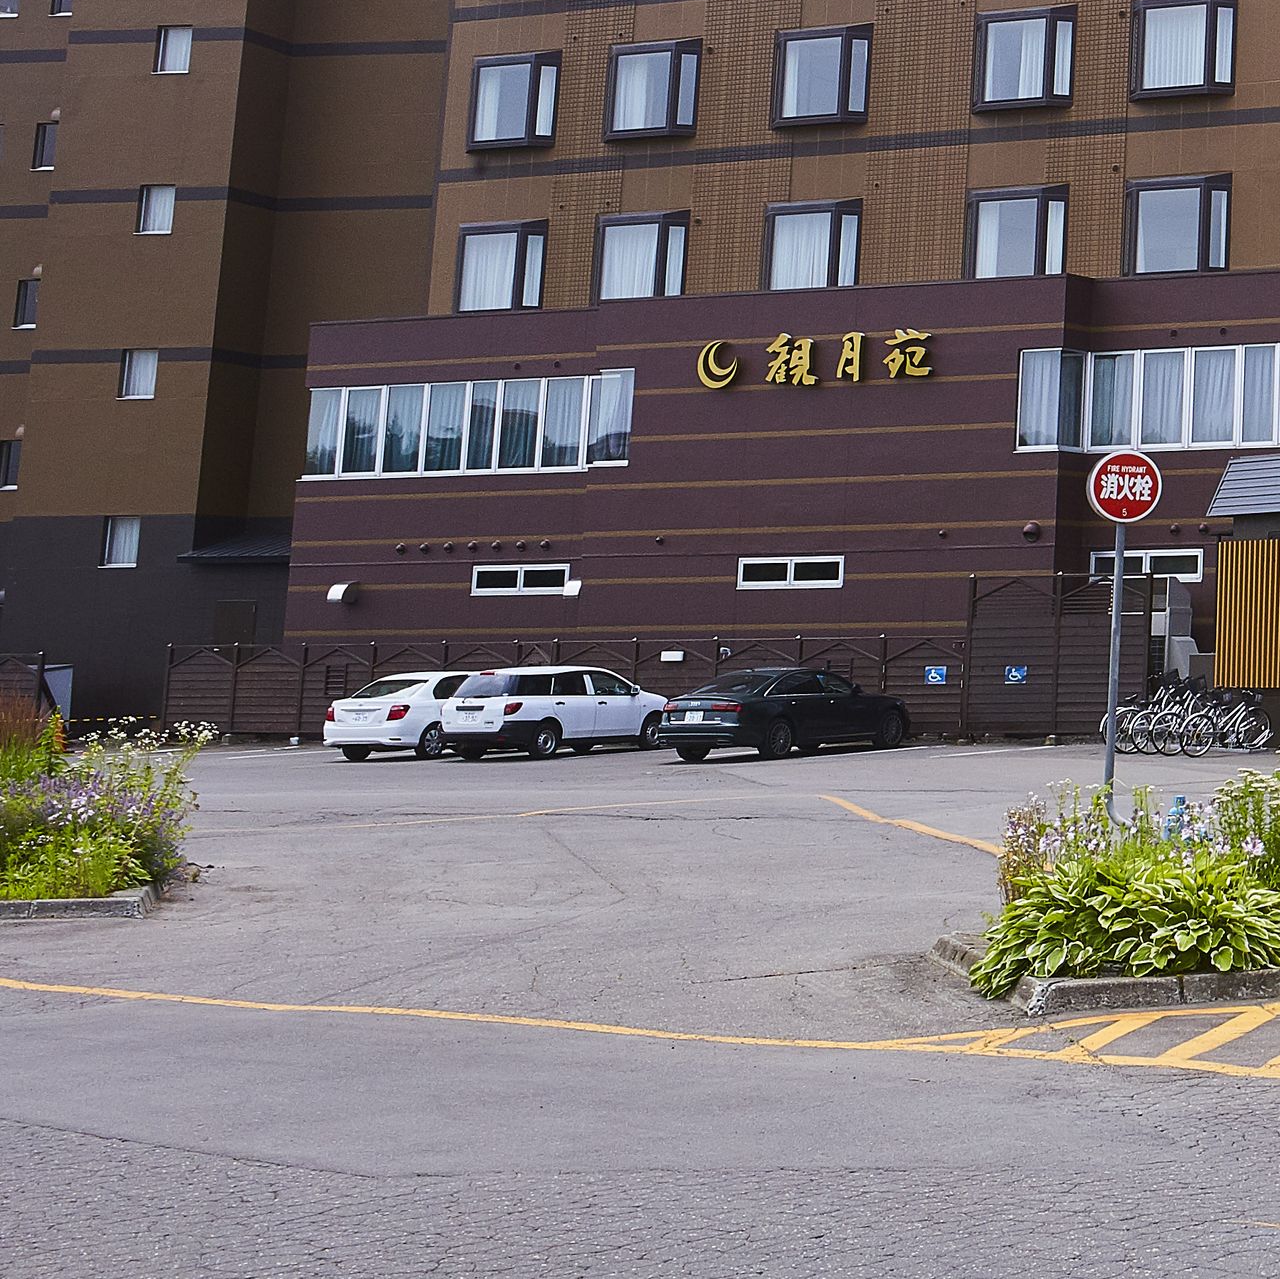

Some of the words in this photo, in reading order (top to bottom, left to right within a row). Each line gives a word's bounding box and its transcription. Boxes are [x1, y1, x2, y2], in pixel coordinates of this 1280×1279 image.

[765, 328, 933, 386] 観月苑
[1107, 465, 1120, 473] FIRE
[1121, 465, 1147, 474] HYDRANT
[1100, 473, 1153, 501] 消火栓
[1122, 508, 1128, 517] 5
